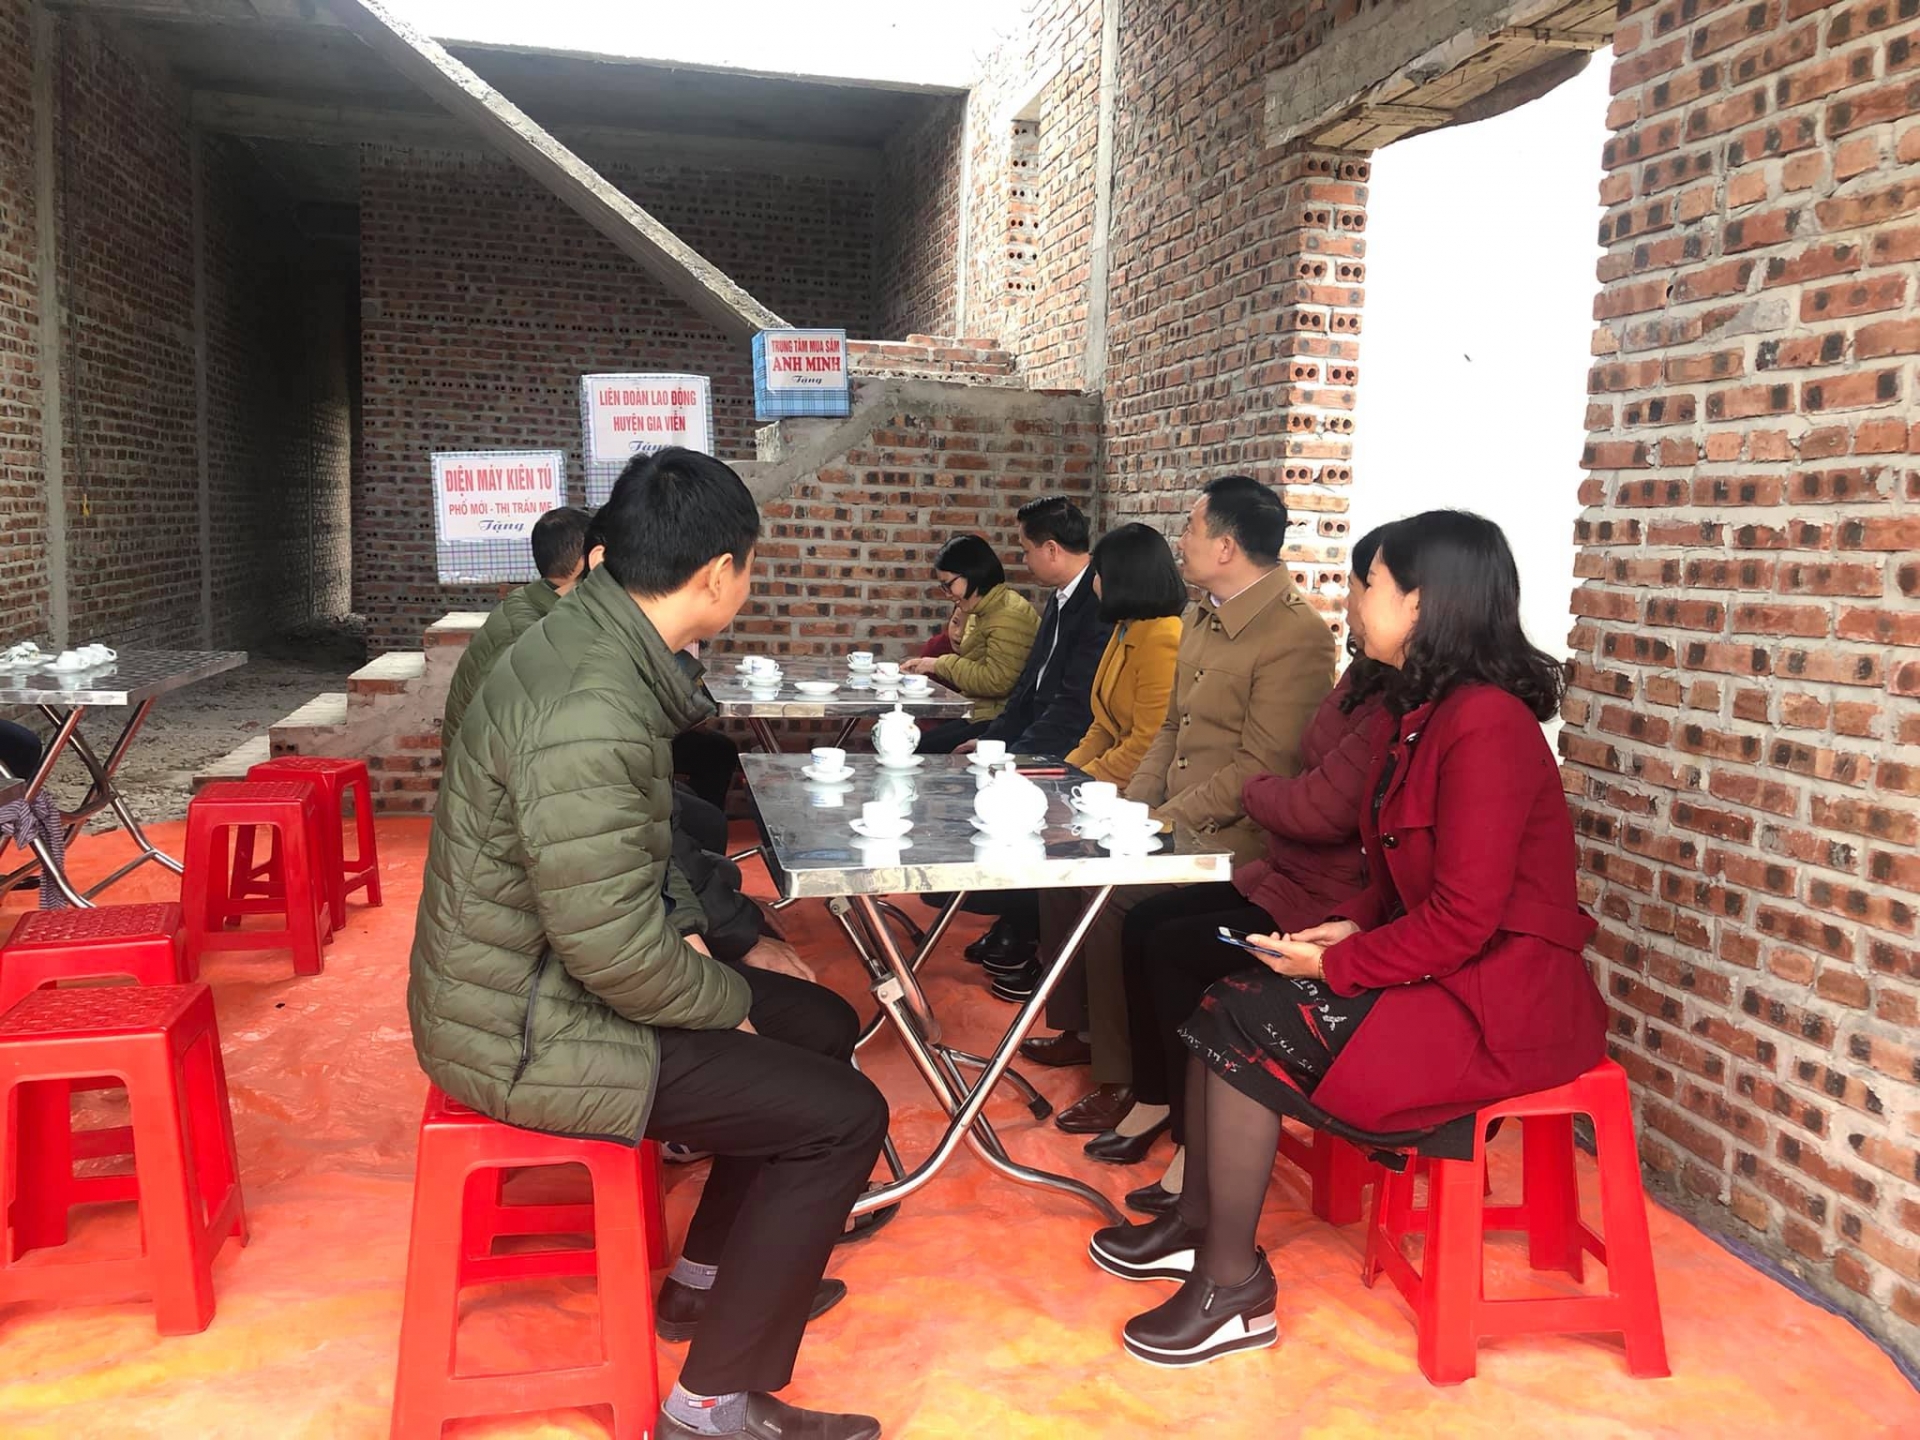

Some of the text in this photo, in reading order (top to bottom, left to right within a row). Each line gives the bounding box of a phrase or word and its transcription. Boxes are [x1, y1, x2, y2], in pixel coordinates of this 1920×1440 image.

[771, 336, 840, 353] TRUNG TÂM MUA SẮM
[772, 356, 841, 371] ANH MINH
[599, 386, 696, 409] LIÊN ĐOÀN LAO ĐỘNG
[613, 412, 644, 435] HUYỆN
[647, 416, 662, 431] GIA
[629, 440, 672, 454] Tặn
[445, 463, 552, 497] ĐIỆN MÁY KIÊN TÚ
[449, 499, 468, 515] PHỐ
[495, 502, 510, 517] THỊ
[512, 497, 536, 514] TRẤN
[479, 519, 524, 533] Tặng
